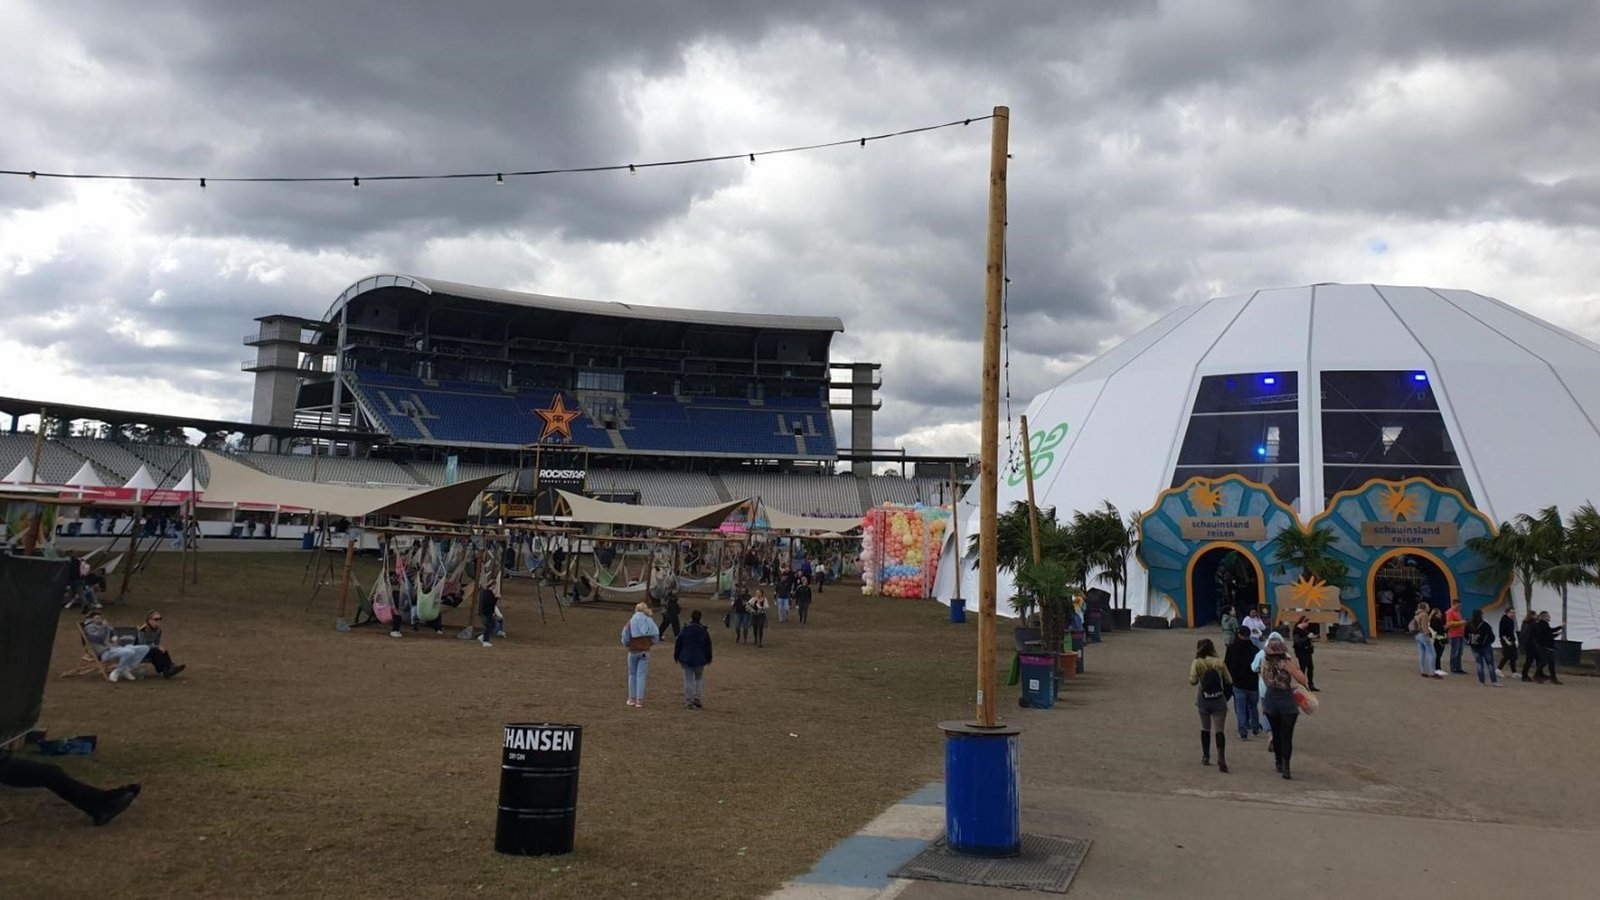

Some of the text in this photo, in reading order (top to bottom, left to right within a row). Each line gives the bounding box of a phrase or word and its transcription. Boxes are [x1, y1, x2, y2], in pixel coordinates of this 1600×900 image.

[539, 469, 585, 479] ROCKSTAR
[1191, 520, 1249, 529] schauinsland
[1207, 529, 1235, 537] reisen
[1374, 525, 1440, 535] schauinsland
[1391, 535, 1424, 544] reisen
[505, 728, 574, 751] HANSEN
